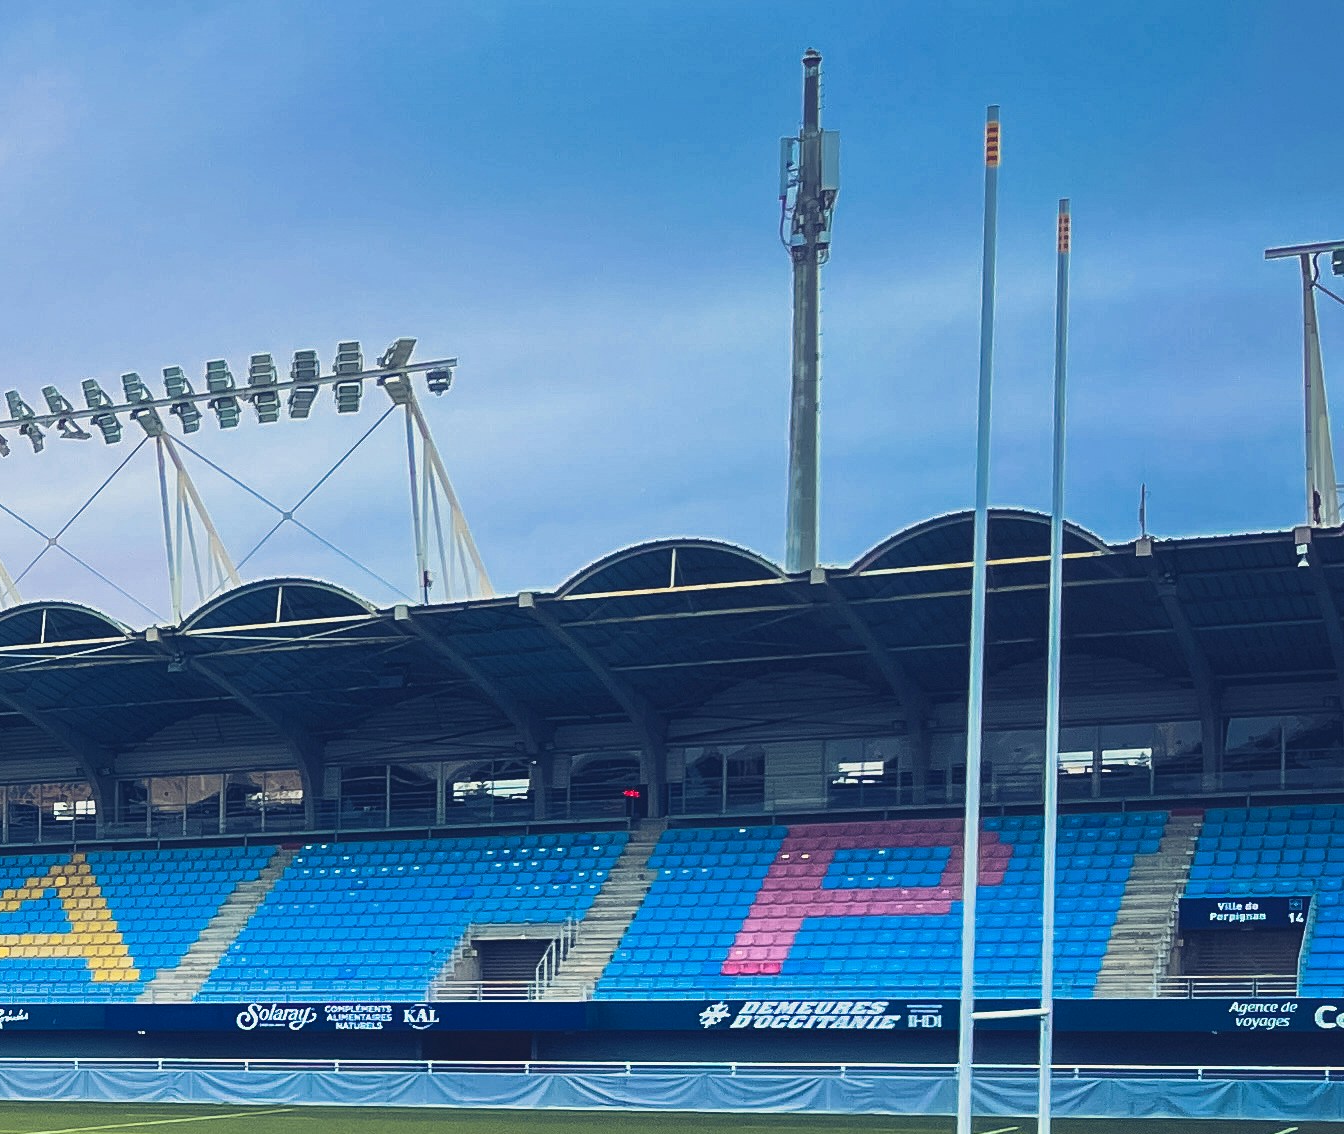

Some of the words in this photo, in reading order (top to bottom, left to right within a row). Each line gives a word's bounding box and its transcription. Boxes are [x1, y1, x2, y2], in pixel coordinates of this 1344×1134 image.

[1217, 902, 1242, 911] Ville
[1245, 902, 1259, 911] de
[1209, 912, 1267, 922] Perpignan
[1288, 913, 1304, 923] 14
[324, 1004, 392, 1013] COMPLÉMENTS
[738, 1001, 890, 1015] DEMEURES
[1229, 1002, 1278, 1016] Agence
[1281, 1001, 1298, 1013] de
[236, 1003, 318, 1031] Solaray
[326, 1013, 393, 1022] ALIMENTAIRES
[403, 1009, 440, 1023] KAL
[729, 1014, 901, 1029] D'OCCITANIE
[335, 1021, 384, 1030] NATURELS
[1235, 1017, 1291, 1030] voyages
